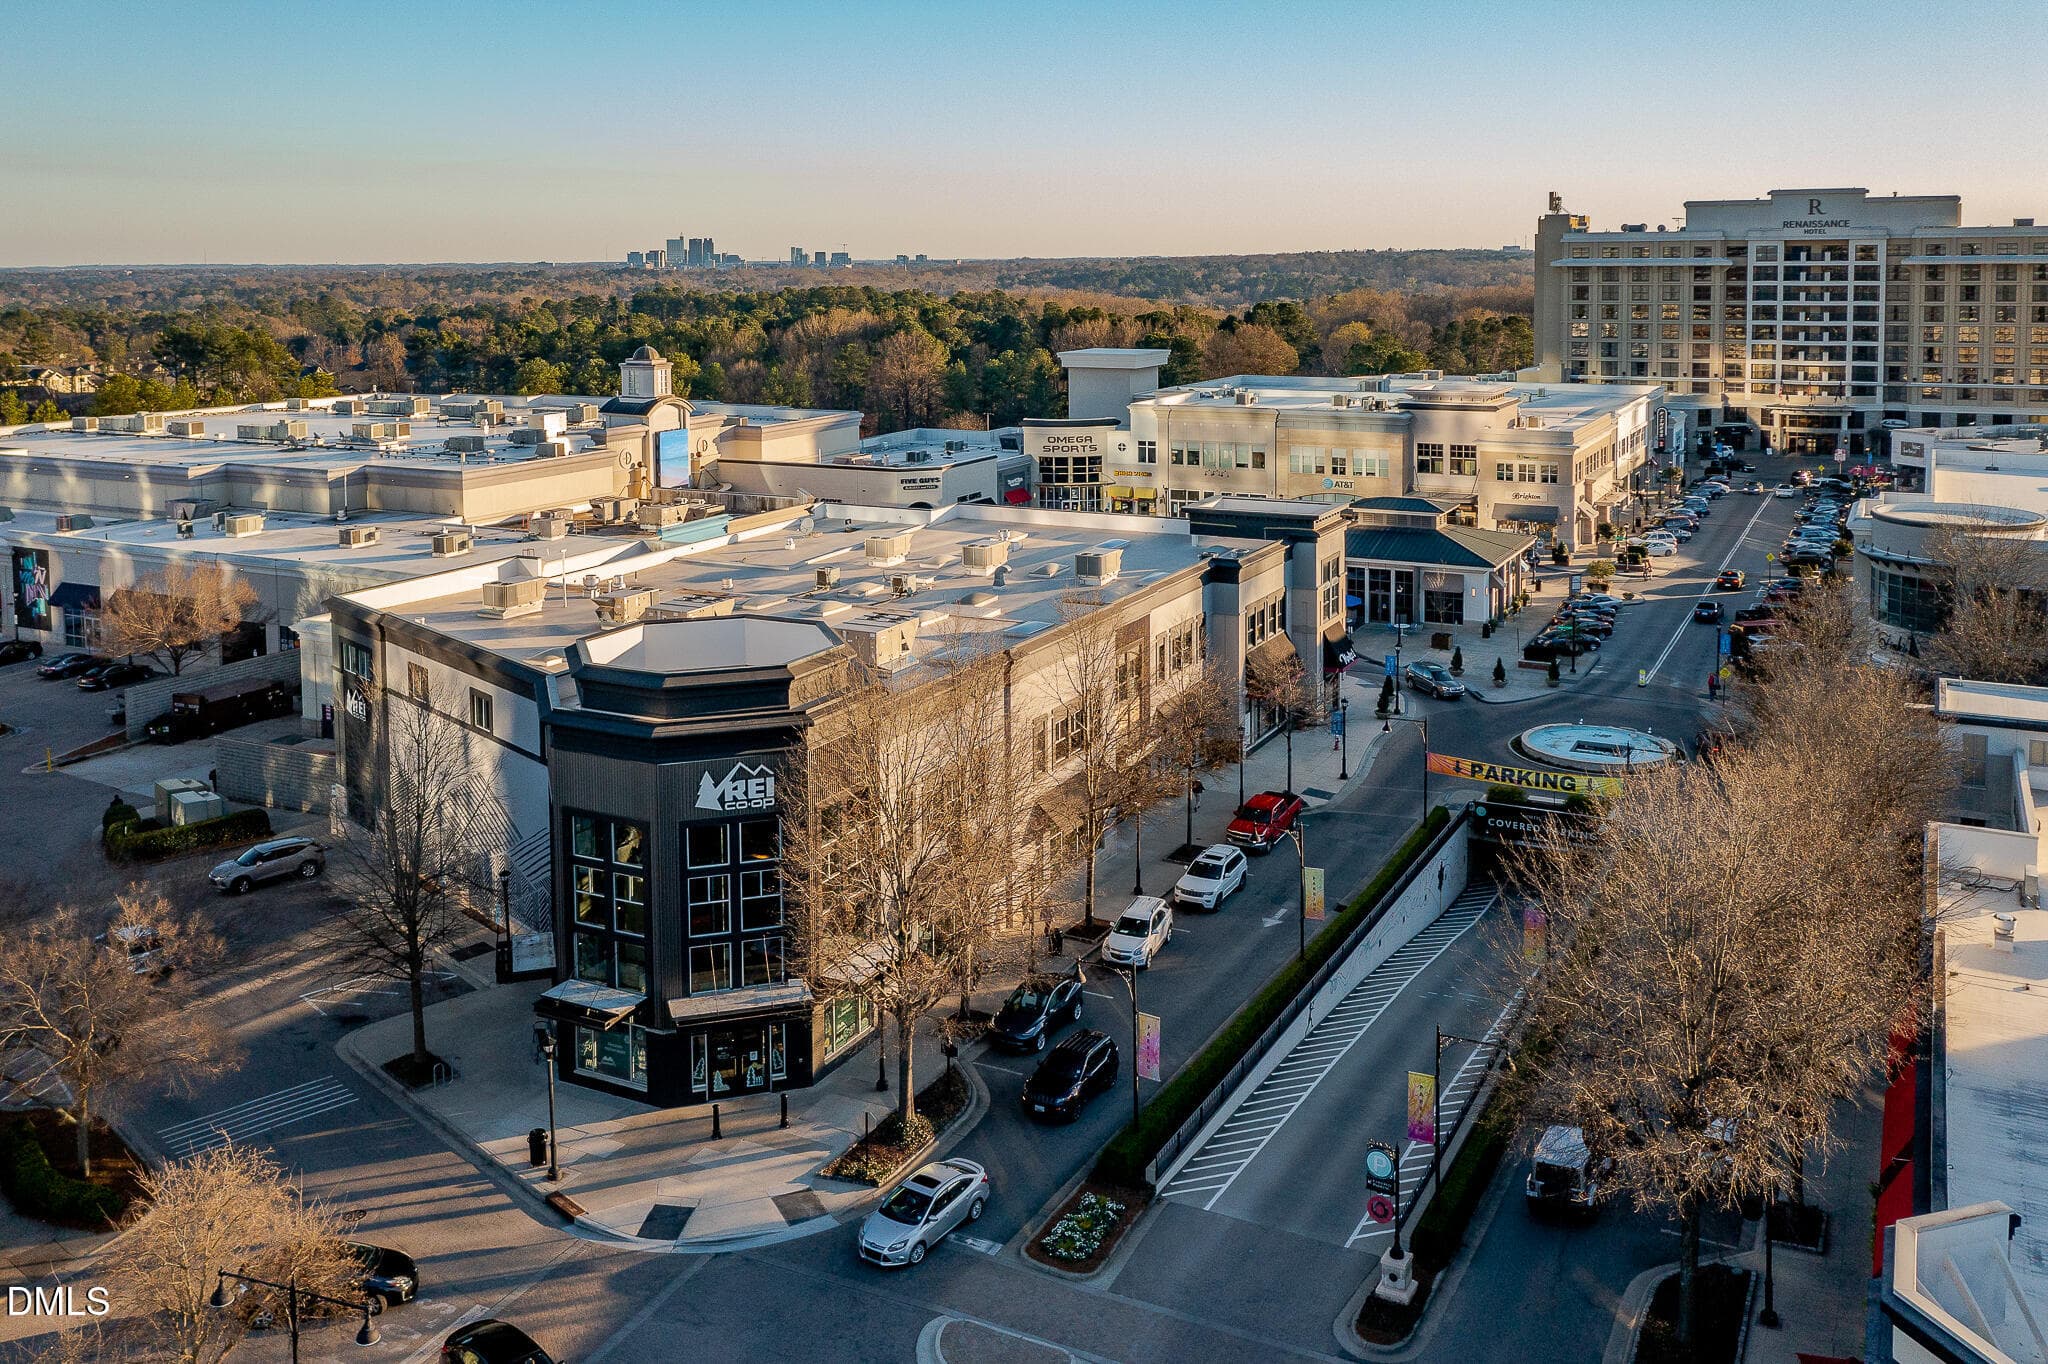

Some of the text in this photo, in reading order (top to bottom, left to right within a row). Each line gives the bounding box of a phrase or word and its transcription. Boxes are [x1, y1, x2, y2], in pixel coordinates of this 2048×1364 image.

[1808, 198, 1827, 215] R
[1783, 219, 1851, 229] RENAISSANCE
[1047, 435, 1093, 444] OMEGA
[1042, 444, 1098, 453] SPORTS
[1334, 481, 1354, 489] AT&T
[1511, 492, 1541, 500] Brighton
[1470, 763, 1577, 792] PARKING
[724, 776, 775, 802] REI
[1488, 818, 1541, 832] COVERED
[1546, 825, 1598, 841] RKING
[1373, 1155, 1387, 1172] P
